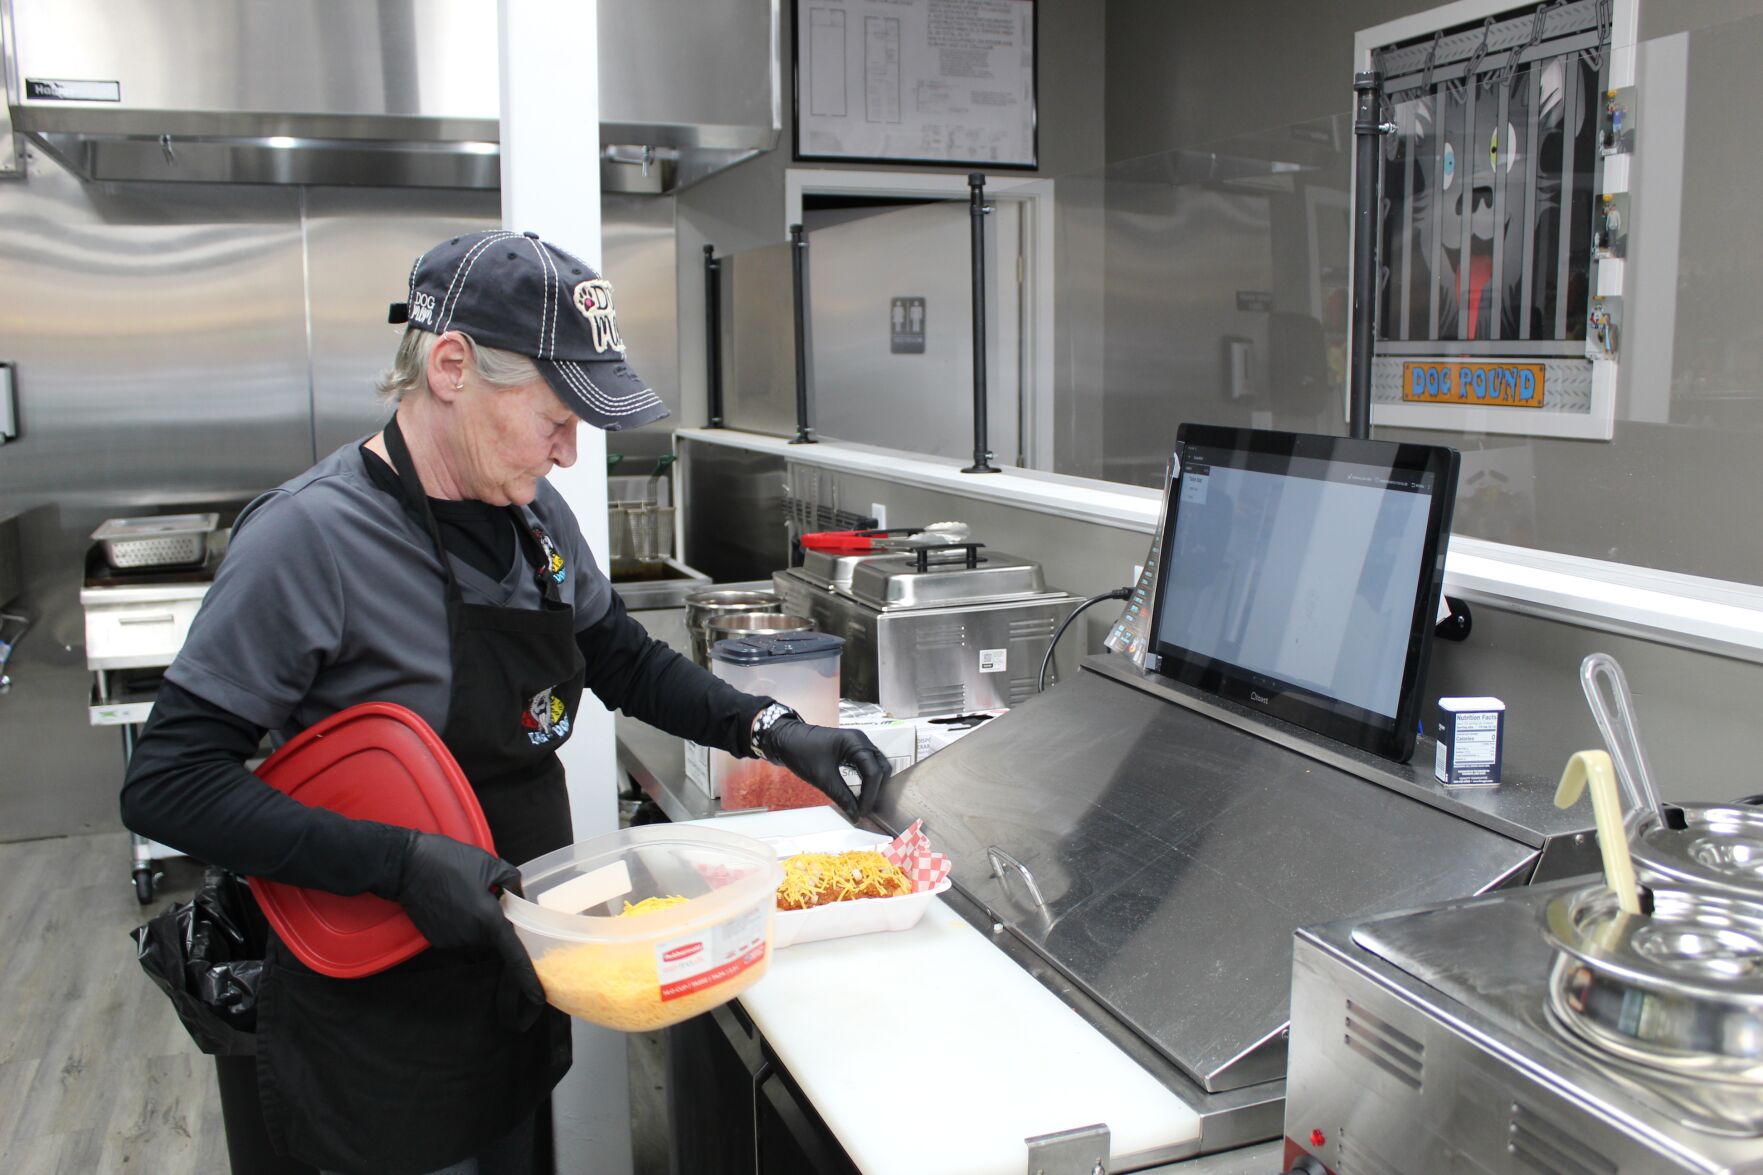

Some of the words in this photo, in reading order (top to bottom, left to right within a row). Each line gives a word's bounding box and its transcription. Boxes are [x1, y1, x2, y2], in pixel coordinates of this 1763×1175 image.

[414, 292, 435, 310] DOG
[1411, 366, 1452, 397] DOG
[1459, 366, 1536, 403] POUND
[1456, 714, 1480, 722] Nutrition
[1482, 713, 1497, 721] Facts
